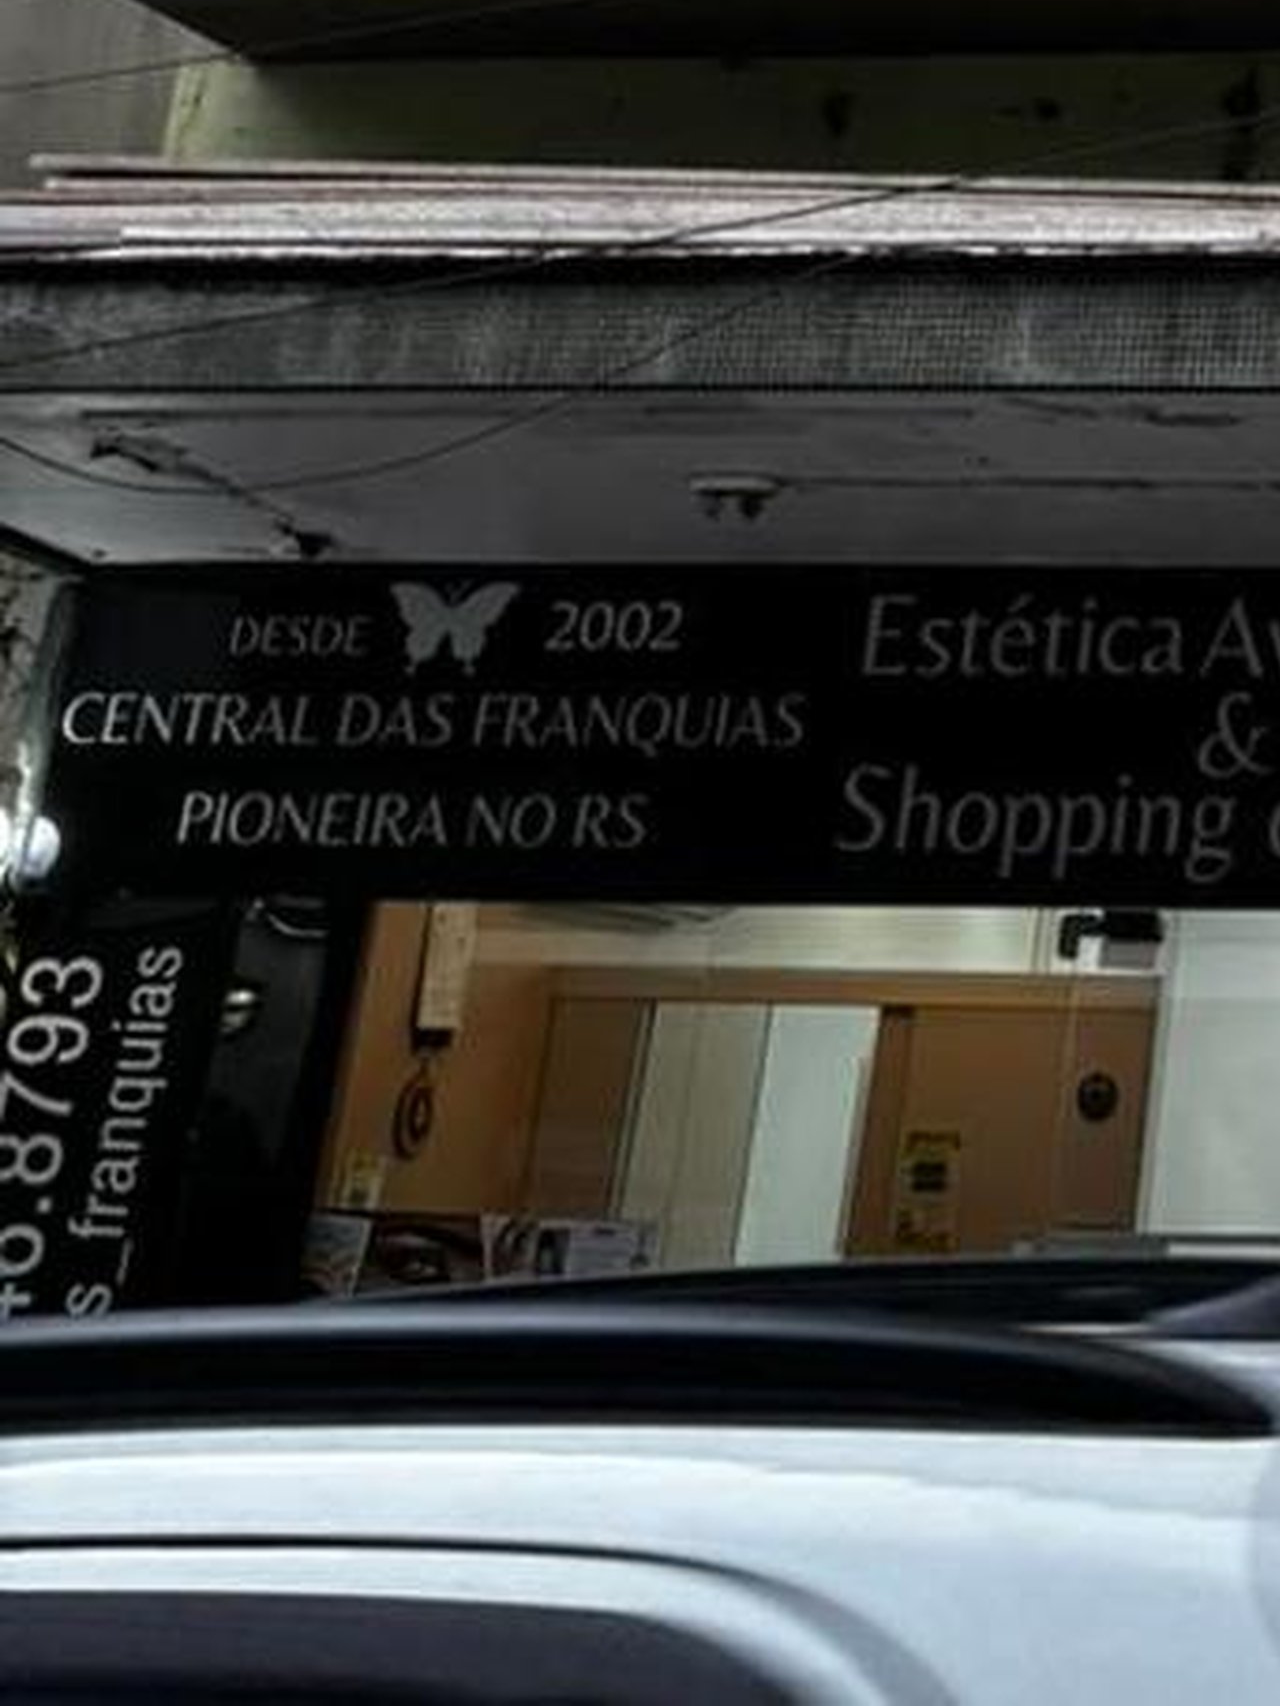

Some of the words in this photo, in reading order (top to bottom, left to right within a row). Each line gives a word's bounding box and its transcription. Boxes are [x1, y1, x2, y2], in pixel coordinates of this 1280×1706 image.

[228, 615, 371, 657] DESDE
[544, 600, 684, 653] 2002
[861, 593, 1184, 678] Estética
[61, 691, 316, 747] CENTRAL
[335, 692, 454, 748] DAS
[471, 692, 805, 758] FRANQUIAS
[1198, 691, 1273, 779] &
[175, 790, 448, 849] PIONEIRA
[467, 793, 557, 849] NO
[572, 794, 648, 849] RS
[835, 765, 1234, 883] Shopping
